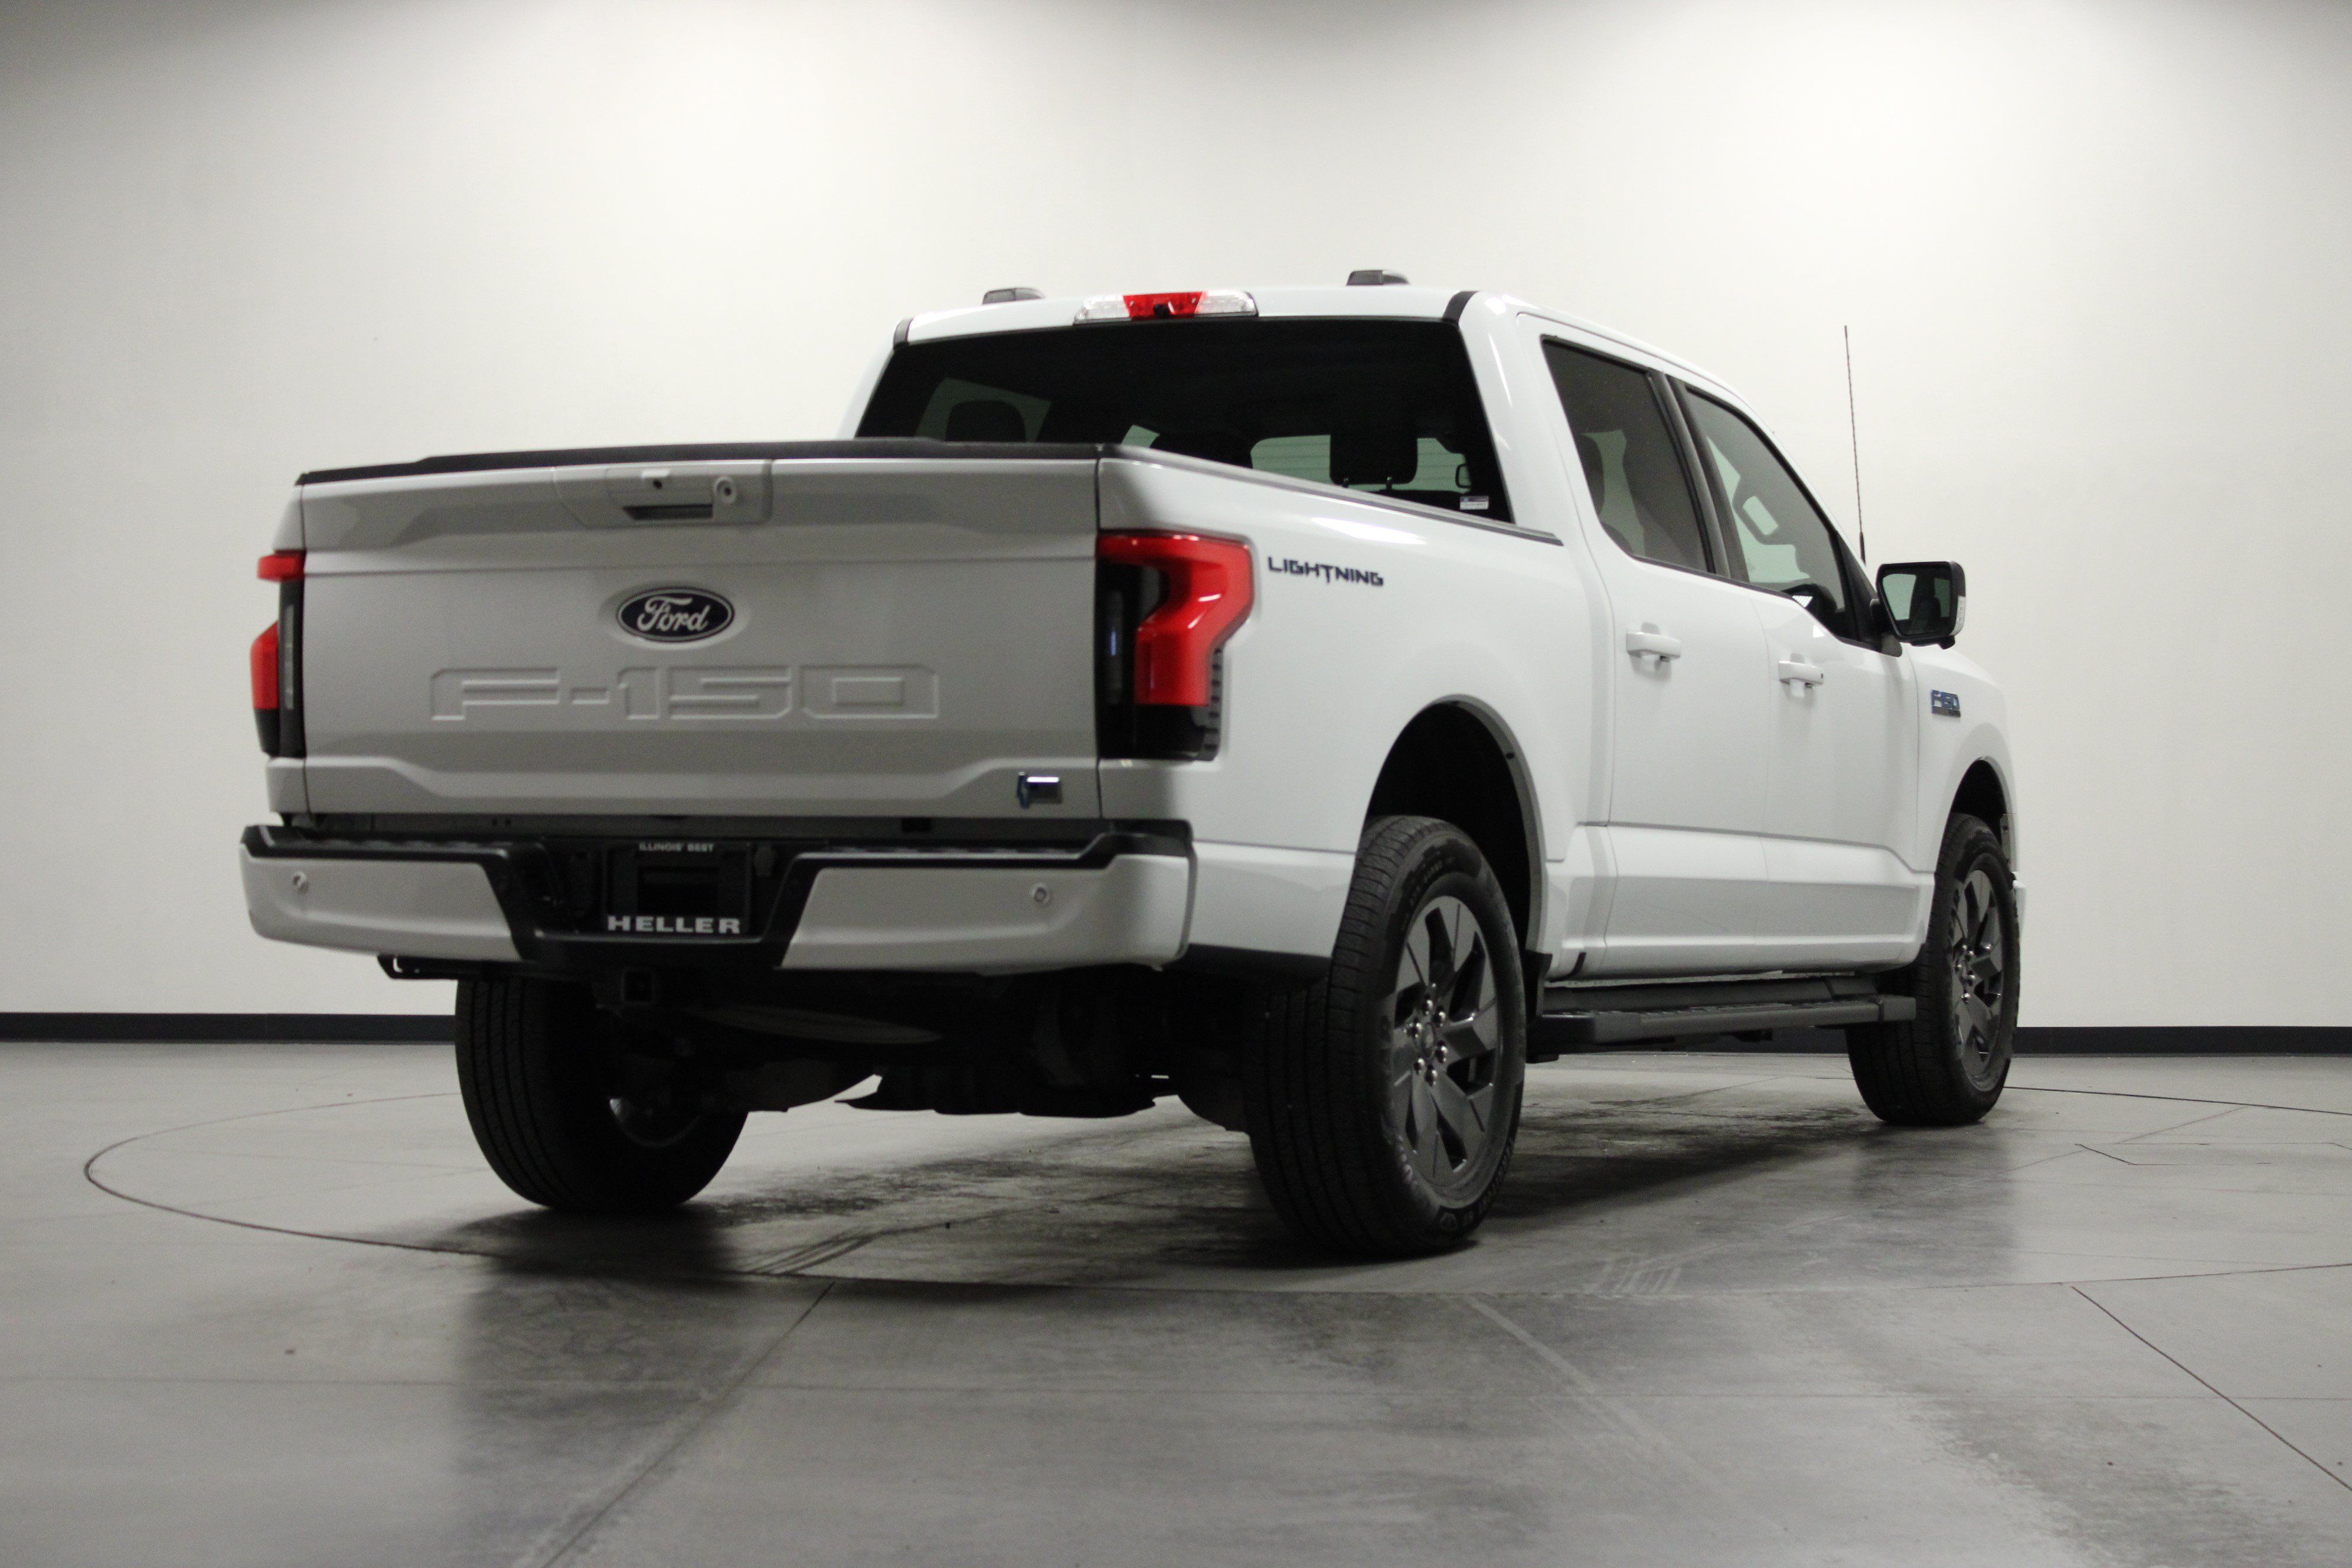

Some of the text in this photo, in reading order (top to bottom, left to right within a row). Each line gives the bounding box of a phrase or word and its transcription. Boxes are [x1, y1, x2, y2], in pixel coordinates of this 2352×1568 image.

[1268, 556, 1384, 587] LIGHTNING
[636, 594, 710, 632] Ford
[430, 664, 940, 721] F-150
[607, 915, 740, 935] HELLER
